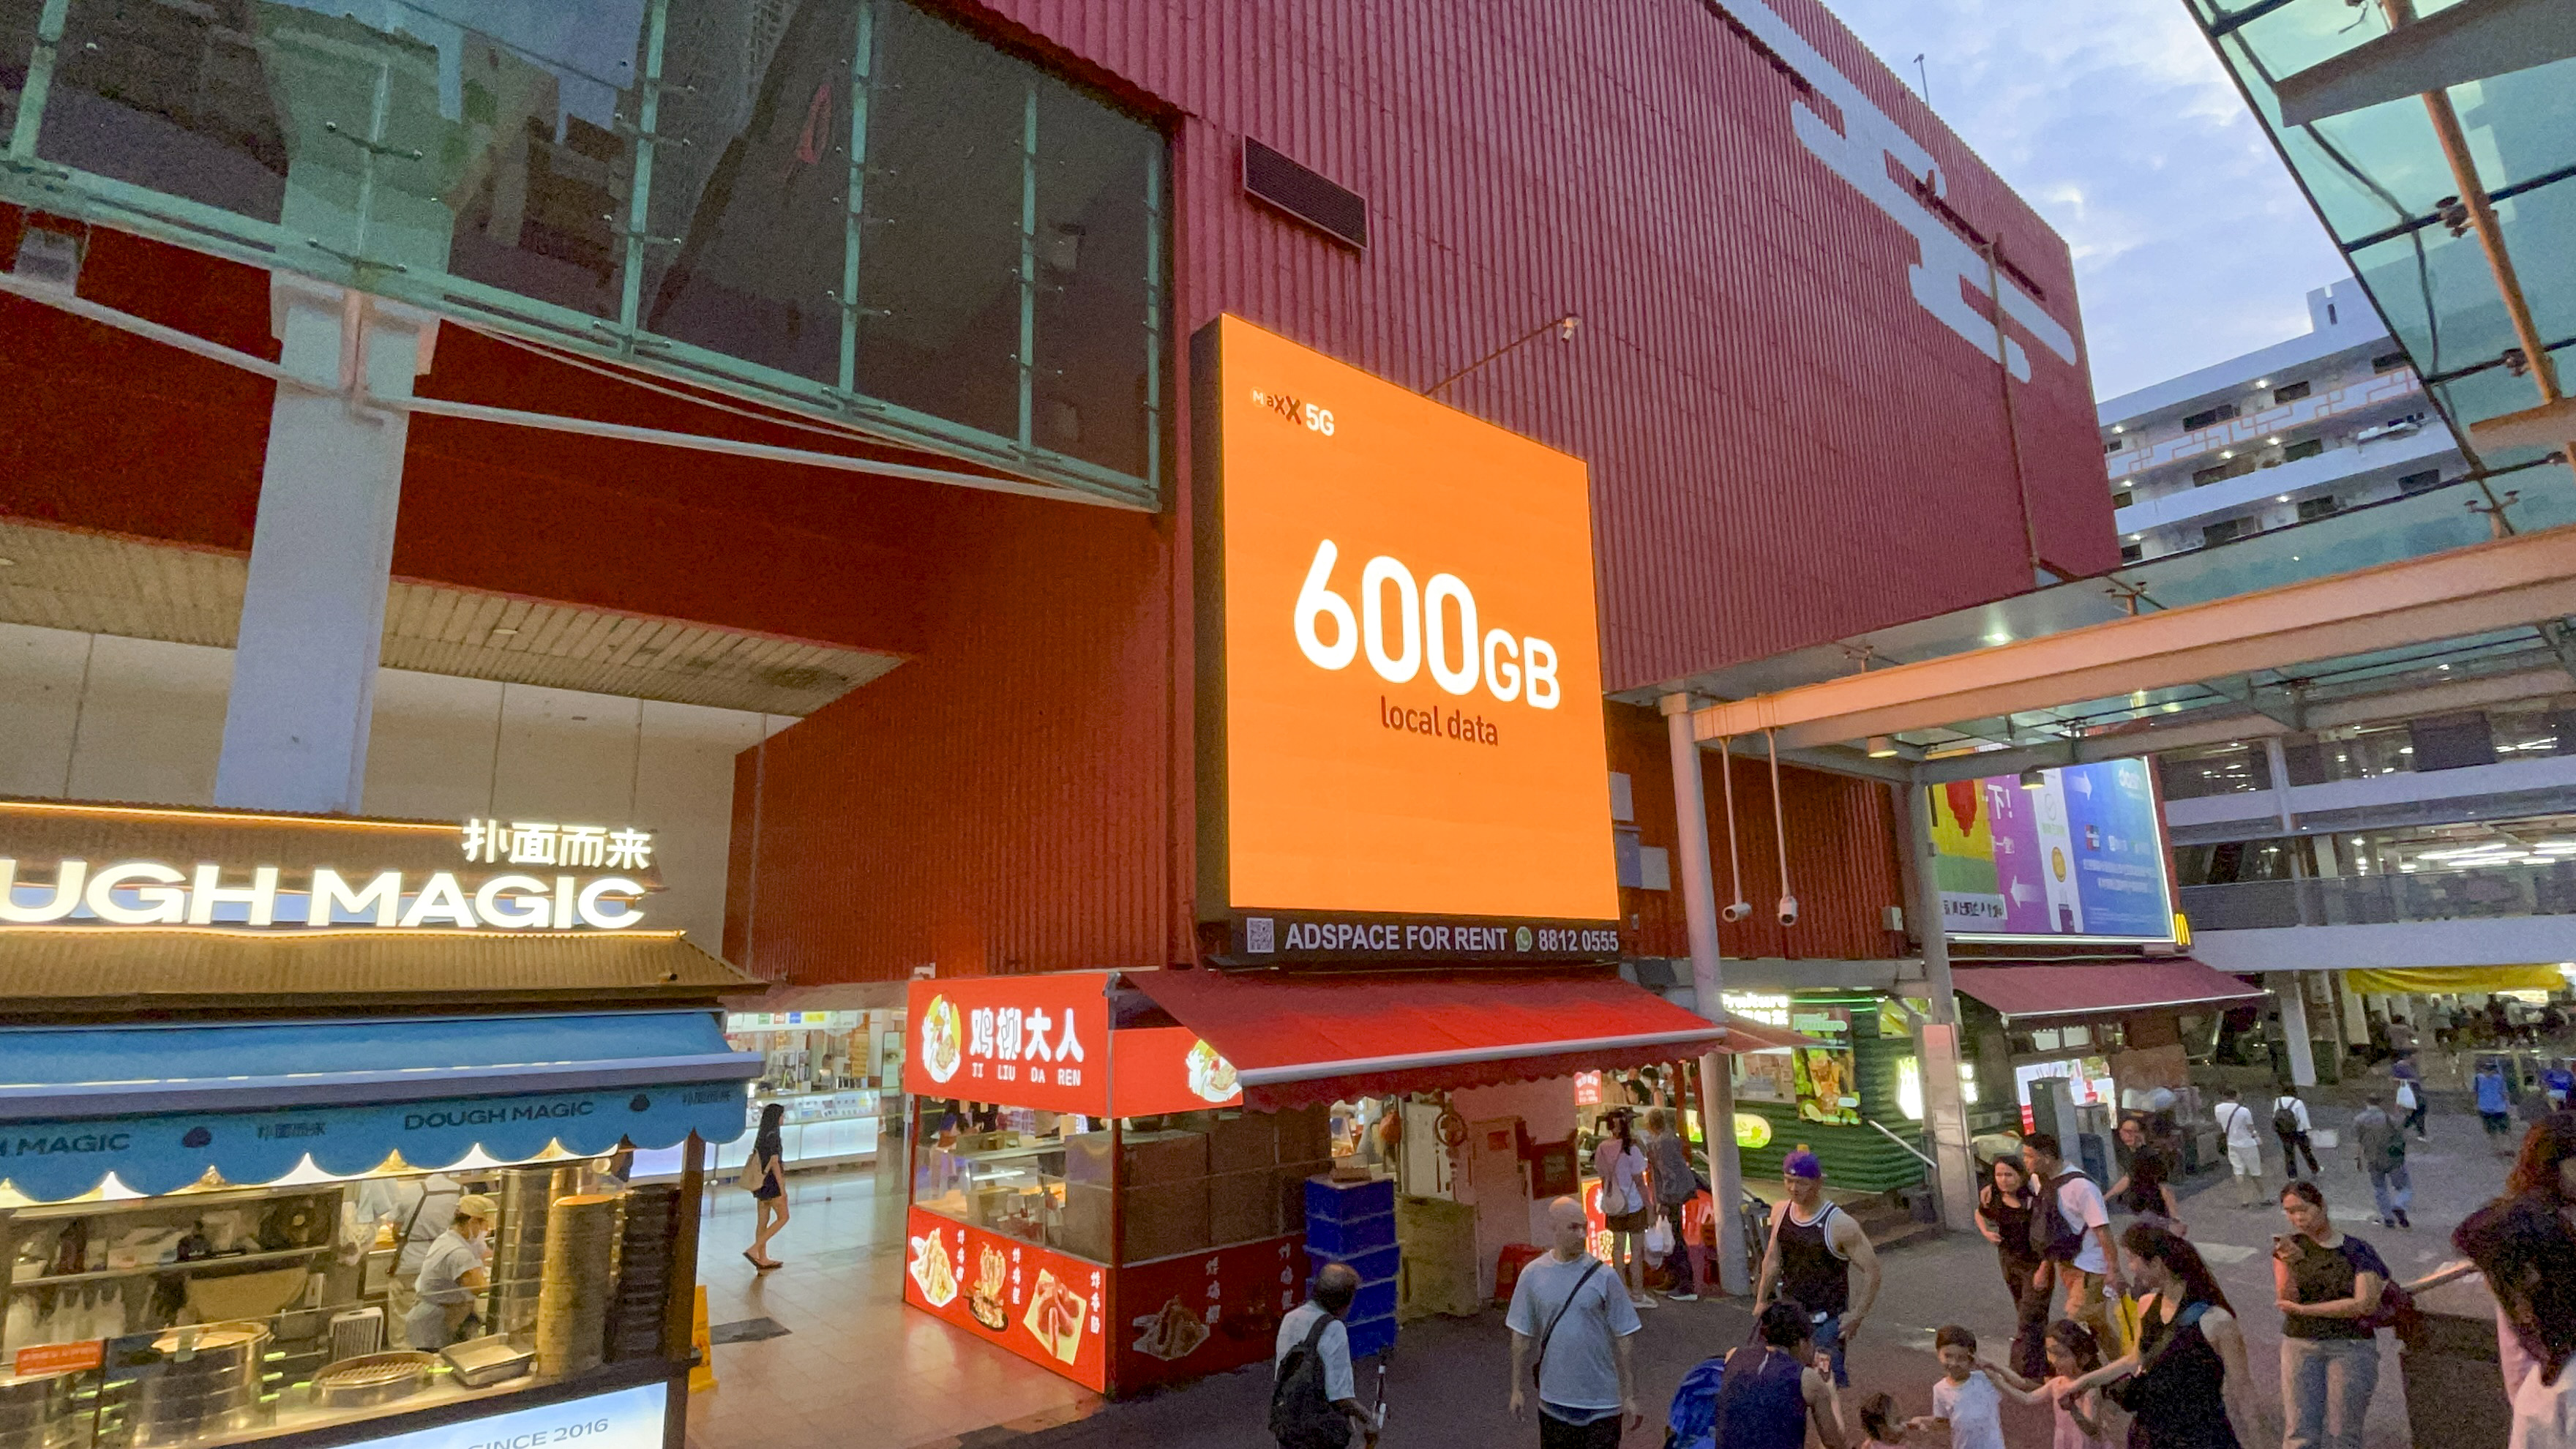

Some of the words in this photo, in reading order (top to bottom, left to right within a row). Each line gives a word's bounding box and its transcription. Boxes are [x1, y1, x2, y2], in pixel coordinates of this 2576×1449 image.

[1306, 403, 1335, 437] 5G
[1293, 539, 1561, 710] 600GB
[1380, 694, 1442, 738] local
[1447, 708, 1499, 747] data
[461, 817, 652, 870] 扑面而来
[0, 858, 279, 926] UGH
[307, 868, 646, 929] MAGIC
[1284, 922, 1400, 951] ADSPACE
[1406, 925, 1450, 951] FOR
[1454, 926, 1508, 951] RENT
[1538, 929, 1578, 951] 8812
[1581, 930, 1620, 952] 0555
[970, 1007, 1085, 1063] 鸡柳大人
[997, 1064, 1016, 1082] LIU
[1030, 1066, 1046, 1084] DA
[1057, 1068, 1081, 1087] REN
[404, 1108, 506, 1131] DOUGH
[512, 1101, 594, 1120] MAGIC
[15, 1132, 130, 1157] MAGIC
[468, 1431, 548, 1449] NCE
[553, 1418, 609, 1442] 2016
